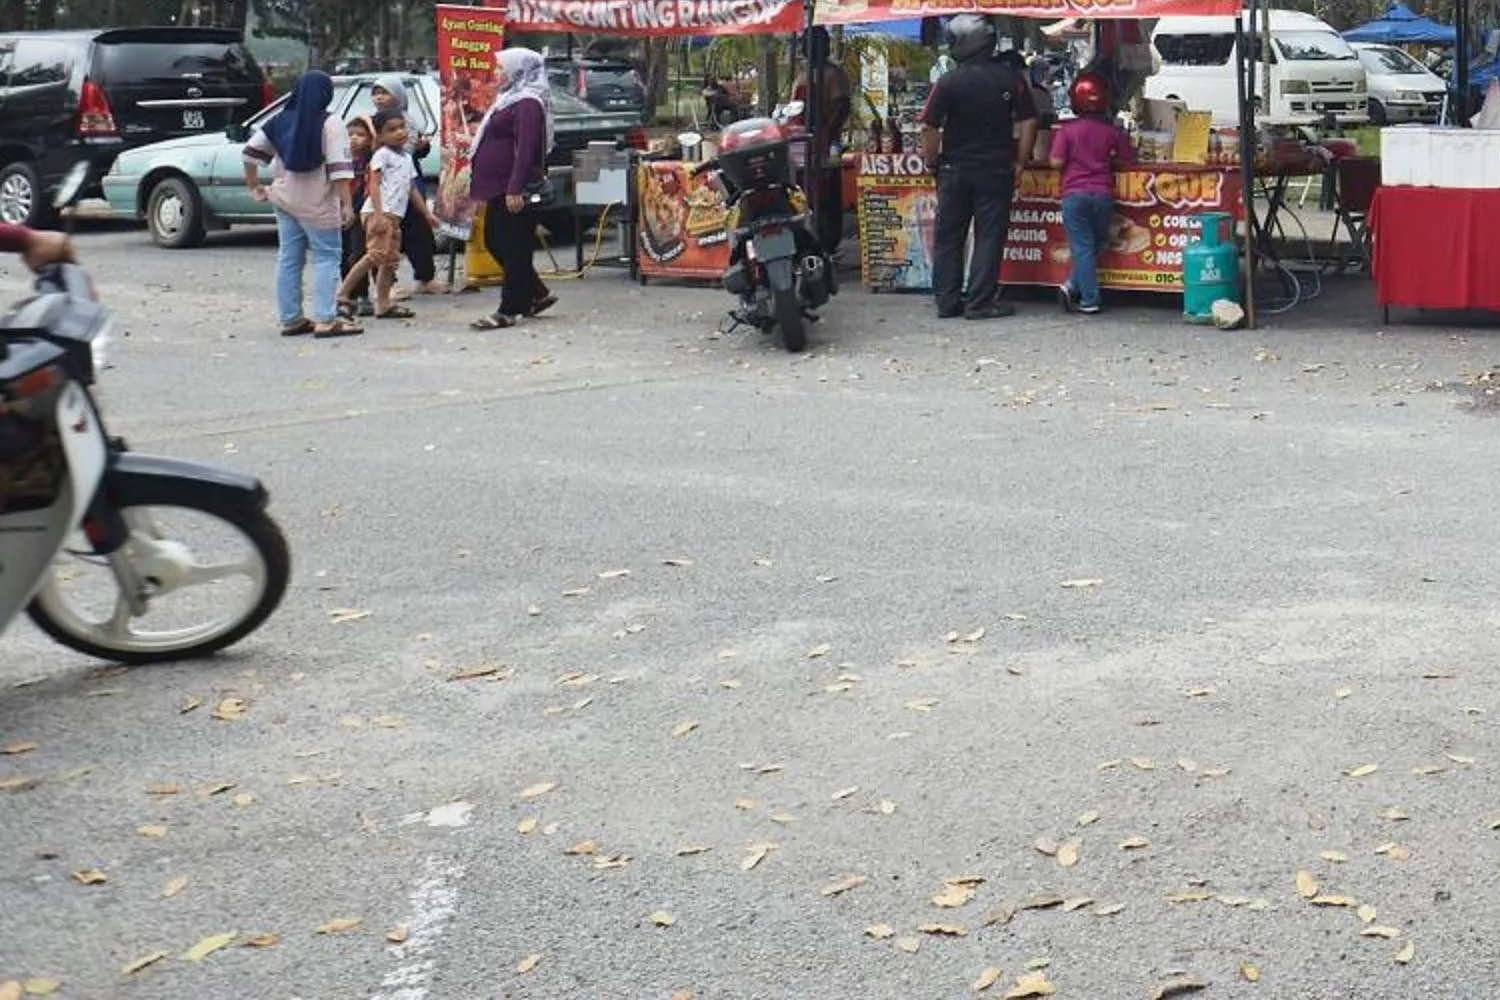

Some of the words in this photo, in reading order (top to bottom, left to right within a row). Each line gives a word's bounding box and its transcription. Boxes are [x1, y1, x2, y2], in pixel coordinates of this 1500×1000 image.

[566, 0, 675, 28] GUNTING
[861, 153, 890, 175] AIS
[1155, 171, 1218, 205] QUE
